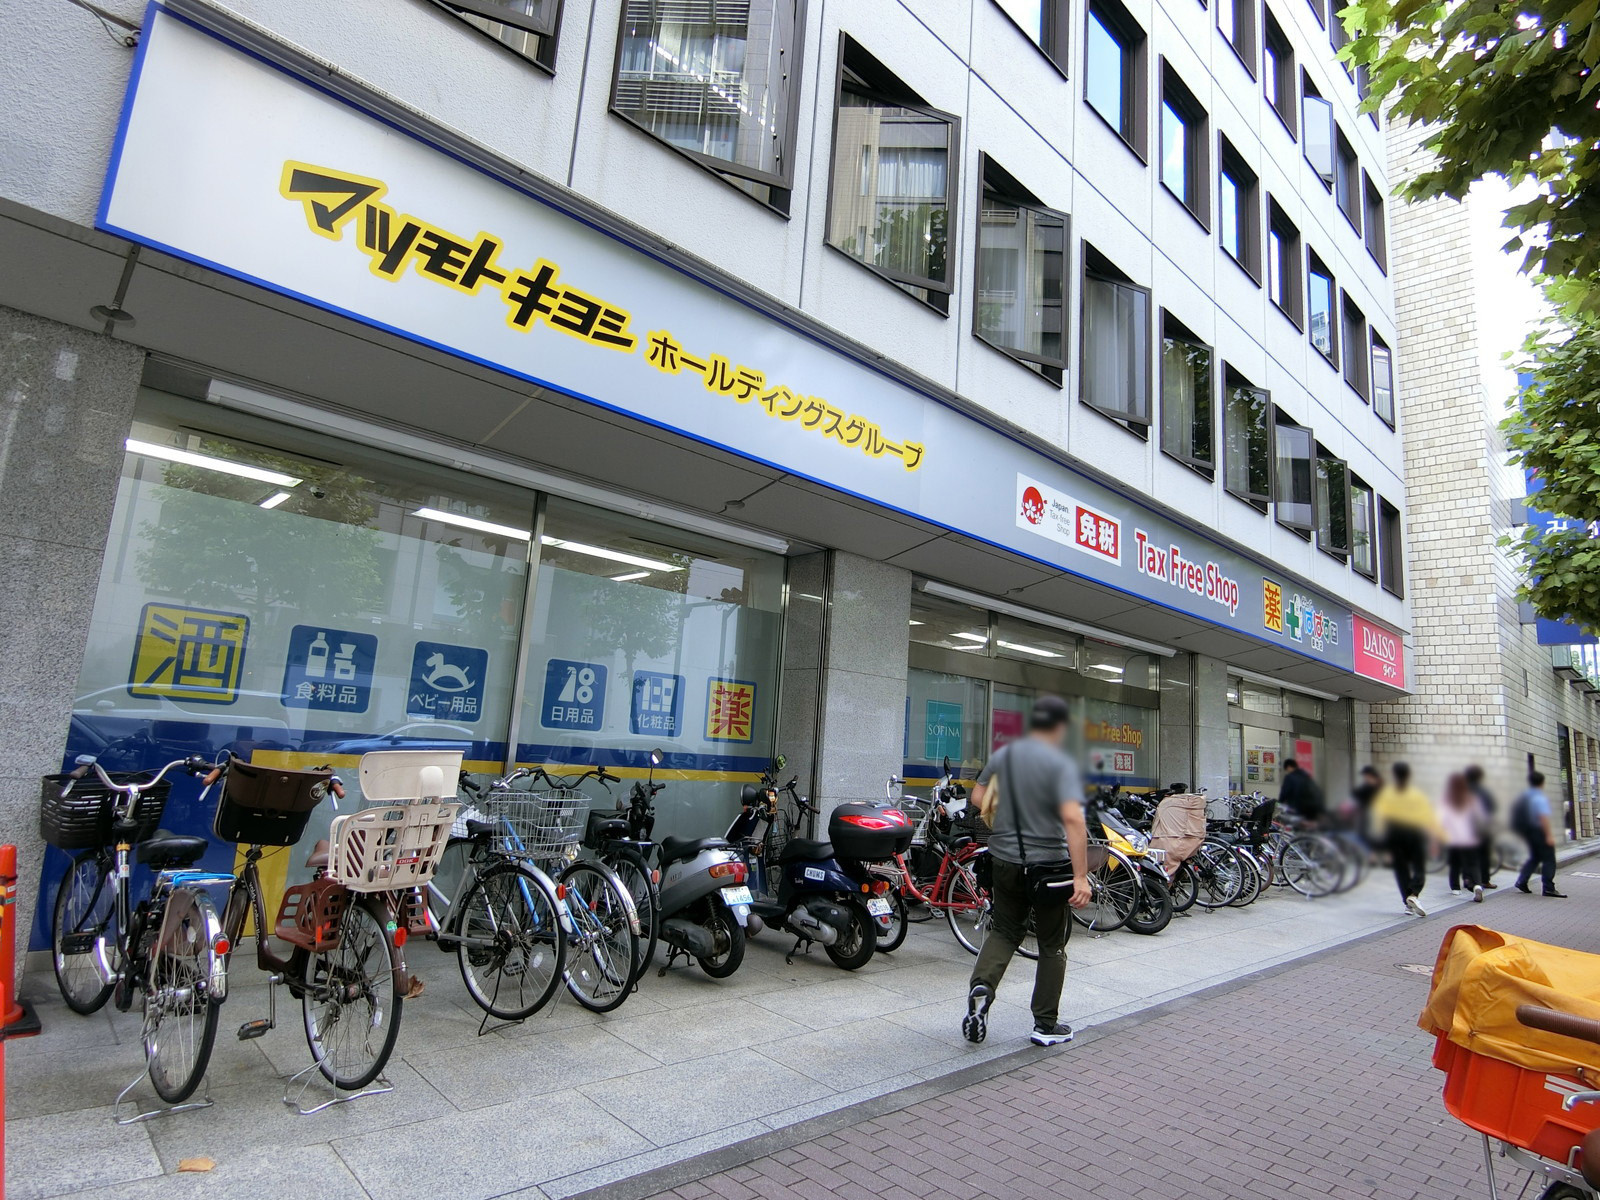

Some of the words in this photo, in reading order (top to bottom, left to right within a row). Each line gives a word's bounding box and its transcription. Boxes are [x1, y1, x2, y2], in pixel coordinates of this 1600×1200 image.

[287, 167, 635, 349] マツモトキヨシ
[649, 336, 923, 468] ホールディングスグループ
[1080, 512, 1115, 555] 免税
[1135, 530, 1166, 579] Tax
[1171, 546, 1204, 593] Free
[1207, 563, 1239, 614] Shop
[1264, 583, 1281, 630] 薬
[141, 612, 241, 695] 酒
[1363, 626, 1396, 661] DAISO
[294, 680, 358, 706] 食料品
[410, 693, 477, 715] ベビー用品
[710, 684, 751, 737] 薬
[551, 706, 595, 725] 日用品
[637, 713, 676, 731] 化粧品
[927, 723, 961, 738] SOFINA
[1122, 723, 1142, 750] Shop
[805, 868, 824, 880] CHUMS
